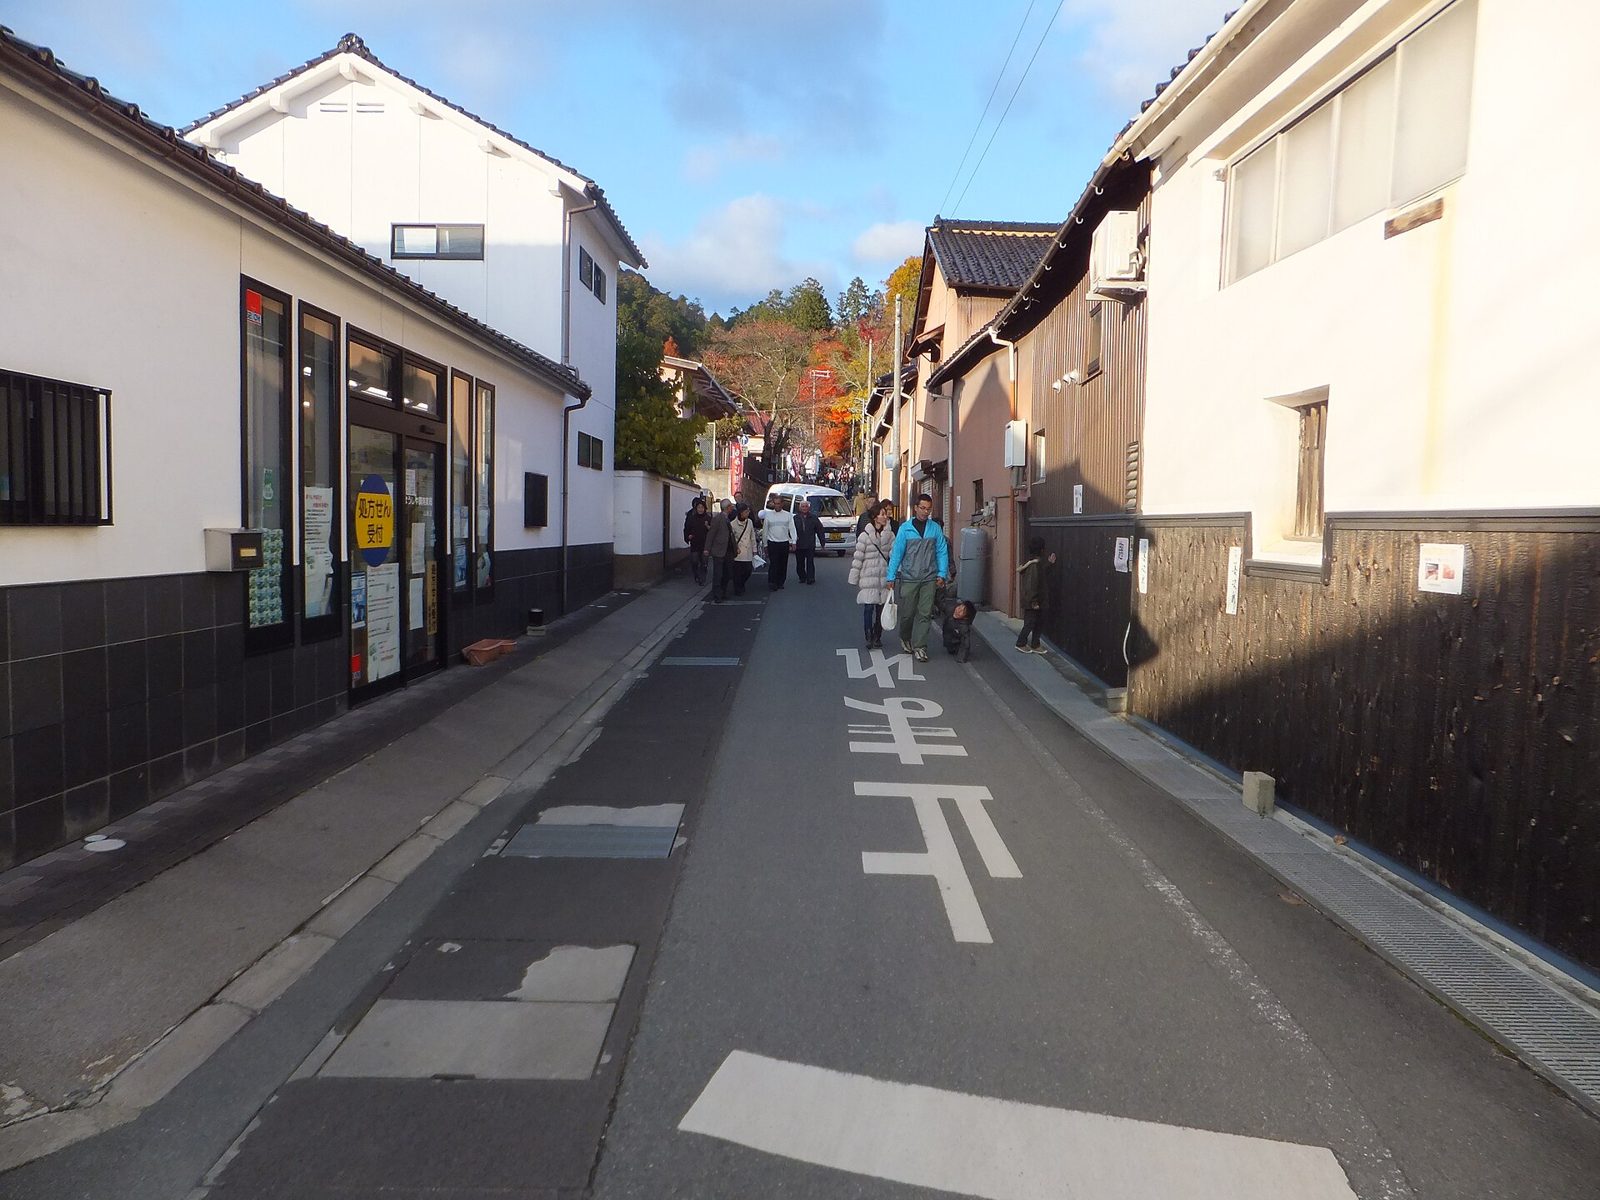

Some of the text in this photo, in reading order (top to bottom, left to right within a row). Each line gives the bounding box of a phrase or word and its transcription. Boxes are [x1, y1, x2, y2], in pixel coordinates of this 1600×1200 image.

[359, 498, 391, 519] 処方せん
[367, 524, 383, 544] 受付
[836, 647, 1024, 944] 止まれ
